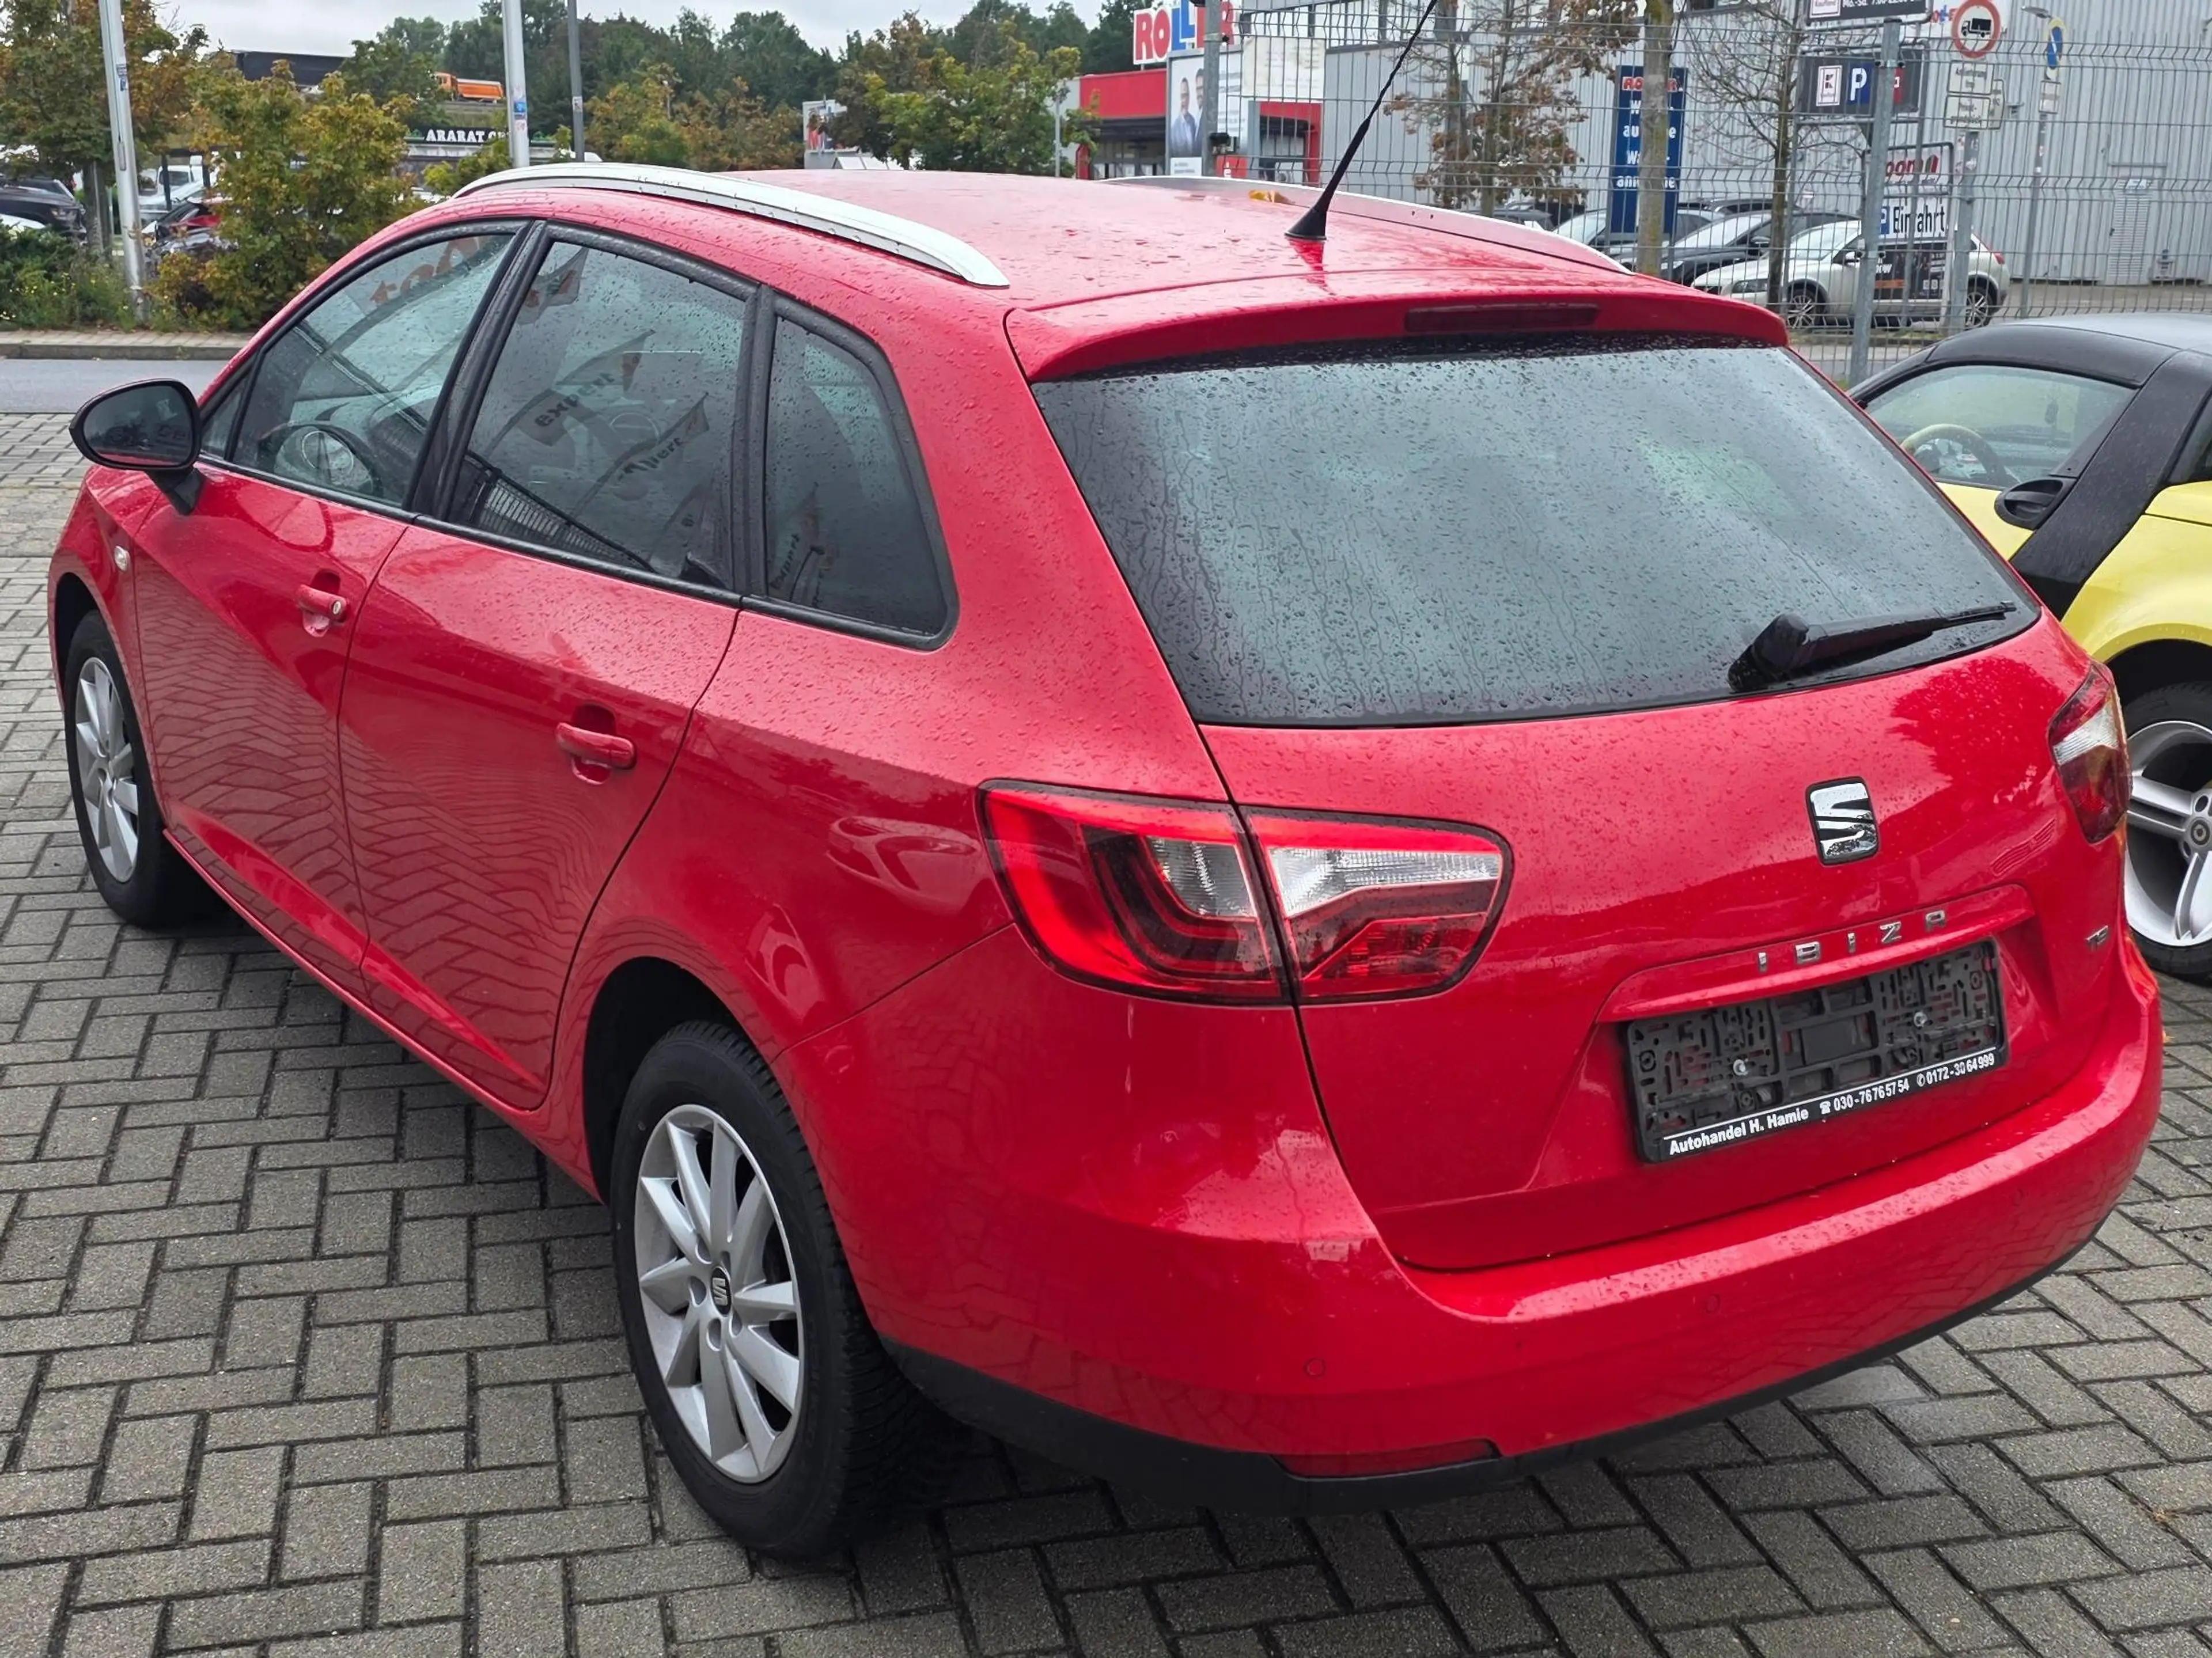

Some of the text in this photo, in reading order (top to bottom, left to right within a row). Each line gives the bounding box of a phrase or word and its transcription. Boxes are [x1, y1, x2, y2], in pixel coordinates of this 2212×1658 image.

[1850, 68, 1867, 101] P
[426, 128, 485, 143] ARARAT
[1893, 204, 1945, 233] Einahrt
[1758, 910, 1946, 972] IBIZA
[1669, 1122, 1747, 1155] Autohandel
[1749, 1118, 1764, 1133] H.
